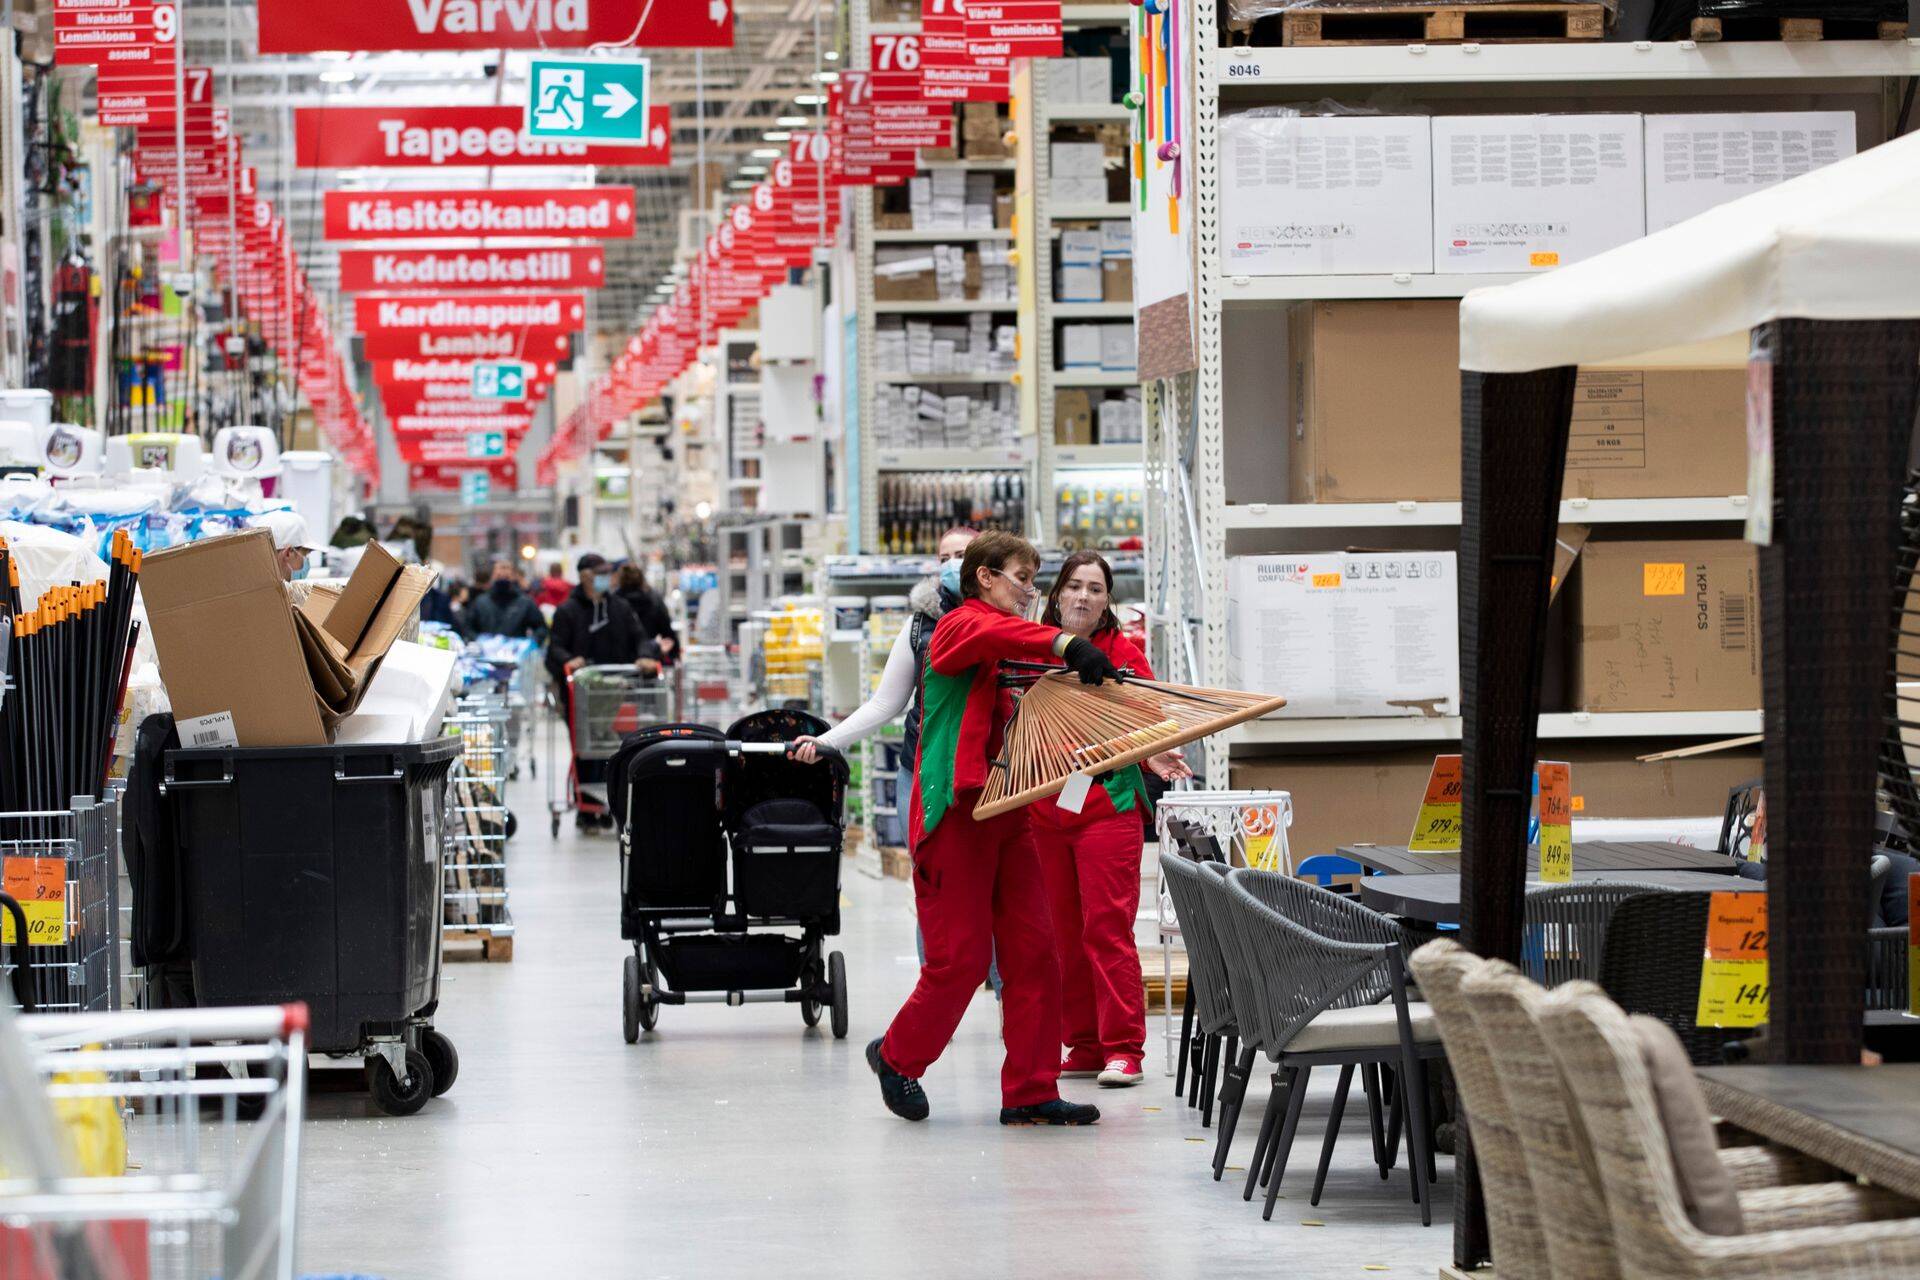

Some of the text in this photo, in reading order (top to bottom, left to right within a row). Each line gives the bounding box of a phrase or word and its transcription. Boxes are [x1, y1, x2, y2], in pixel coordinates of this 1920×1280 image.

[152, 5, 177, 42] 9
[108, 47, 150, 60] asemed
[874, 36, 920, 71] 76
[1228, 64, 1261, 77] 8046
[187, 69, 209, 102] 7
[792, 133, 830, 162] 70
[349, 198, 611, 231] Käsitöökaubad
[373, 252, 571, 283] Kodutekstiil
[378, 300, 561, 329] Kardinapuud
[420, 332, 514, 356] Lambid
[1257, 564, 1297, 574] ALLIBERT
[1257, 575, 1285, 583] CORFU
[1695, 573, 1709, 631] KPL/PCS
